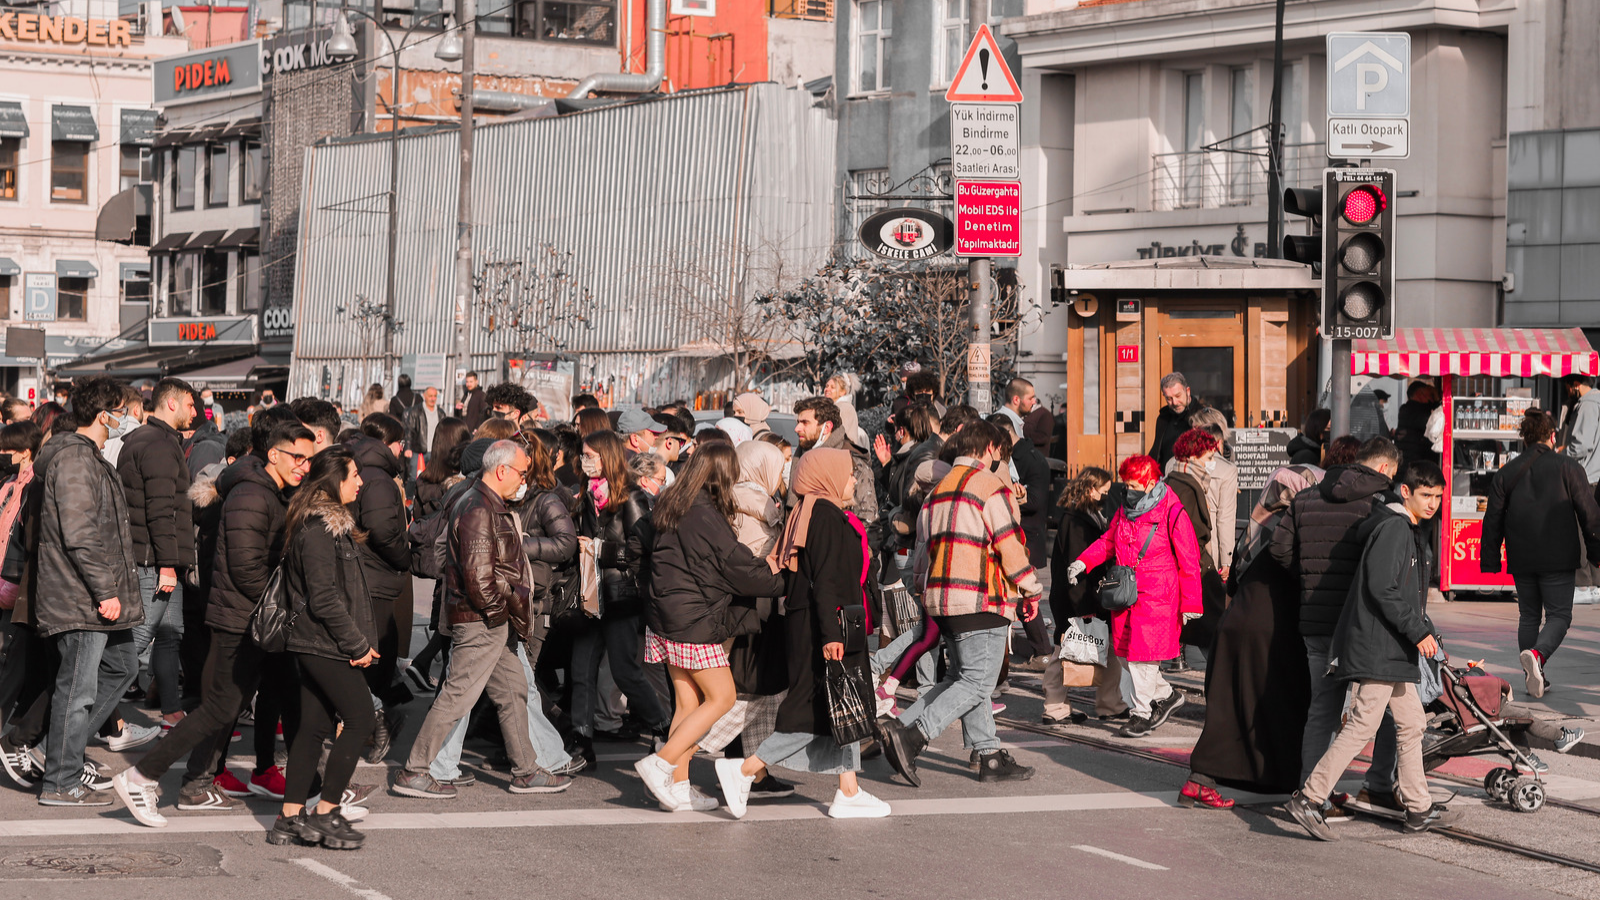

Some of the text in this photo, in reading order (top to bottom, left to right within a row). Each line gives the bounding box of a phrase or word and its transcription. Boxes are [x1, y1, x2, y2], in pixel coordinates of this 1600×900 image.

[954, 107, 1014, 121] Yük İndirme
[963, 126, 1009, 139] Bindirme
[1333, 123, 1403, 138] Katlı Otopark
[956, 162, 1016, 173] Saatleri Arası
[958, 185, 1018, 198] Bu Güzergahta
[958, 204, 1018, 215] Mobil EDS ile
[964, 220, 1012, 231] Denetim
[958, 238, 1019, 250] Yapılmaktadır
[31, 289, 49, 311] D
[1337, 327, 1379, 338] 15-007
[1121, 348, 1134, 360] 1/1
